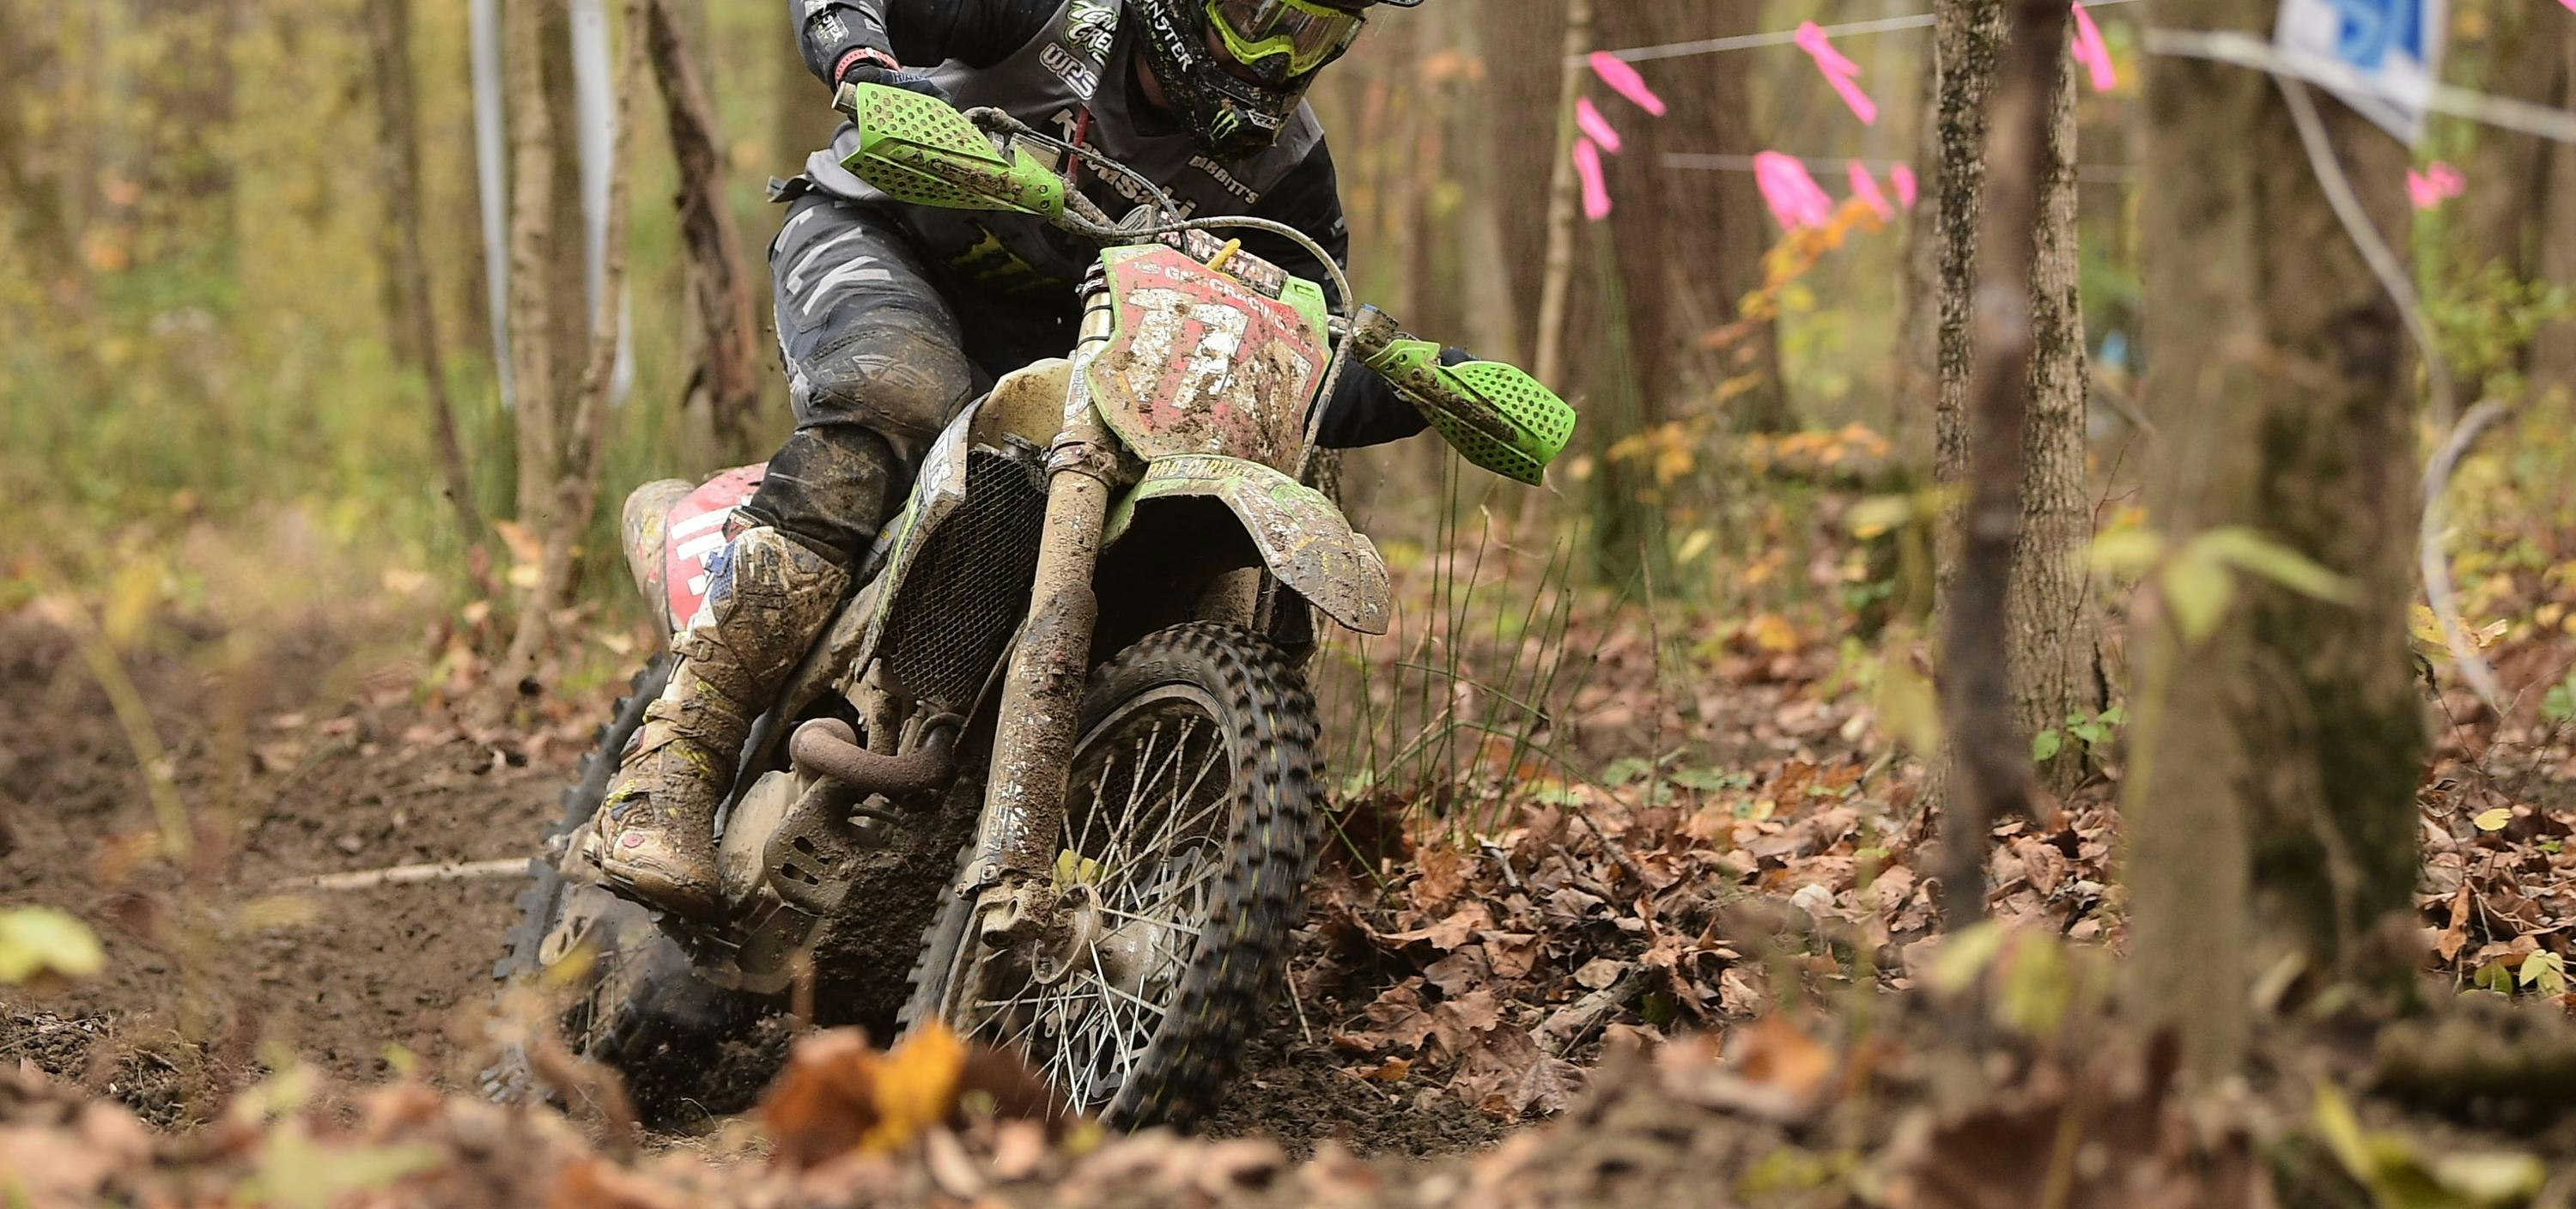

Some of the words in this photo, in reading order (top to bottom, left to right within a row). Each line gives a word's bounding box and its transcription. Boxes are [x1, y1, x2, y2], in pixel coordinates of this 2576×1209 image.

[1067, 22, 1114, 53] GRE
[1147, 0, 1193, 72] NSTER
[1040, 44, 1099, 100] WPS
[1185, 459, 1254, 477] CIRCU
